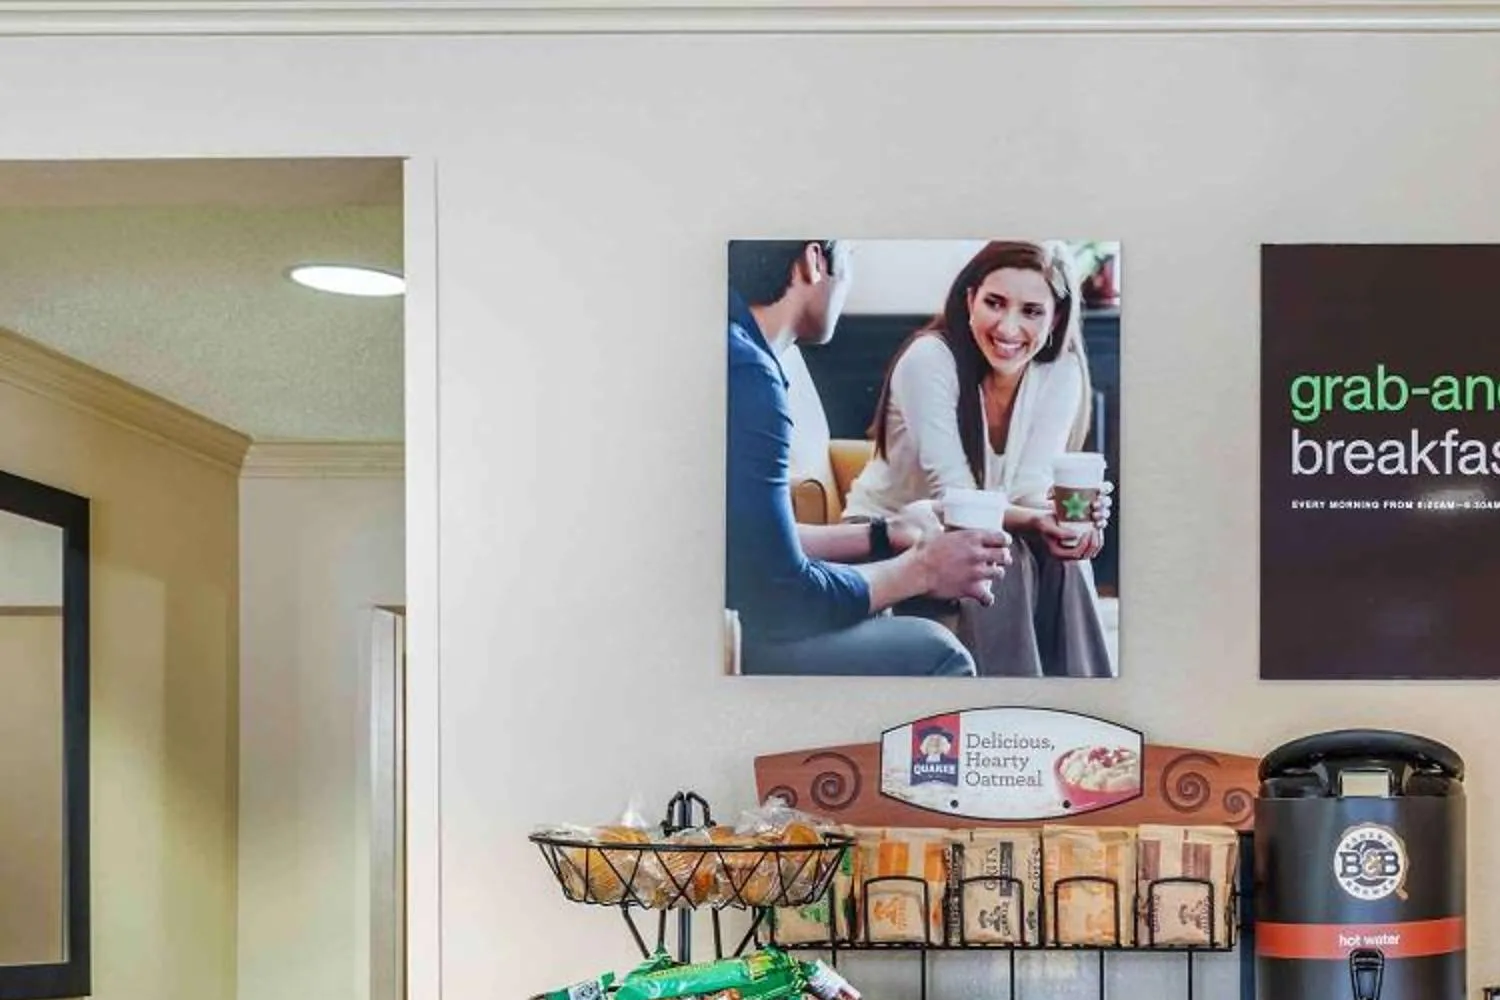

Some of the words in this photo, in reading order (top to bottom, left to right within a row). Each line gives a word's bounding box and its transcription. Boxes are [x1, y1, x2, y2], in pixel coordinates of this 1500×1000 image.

[1291, 500, 1325, 509] EVERY
[1329, 500, 1380, 509] MORNING
[1383, 500, 1414, 509] FROM
[966, 732, 1056, 751] Delicious,
[966, 752, 1030, 771] Hearty
[913, 763, 956, 775] QUAKER
[965, 771, 1043, 787] Oatmeal
[1339, 934, 1361, 946] hot
[1363, 933, 1400, 945] water
